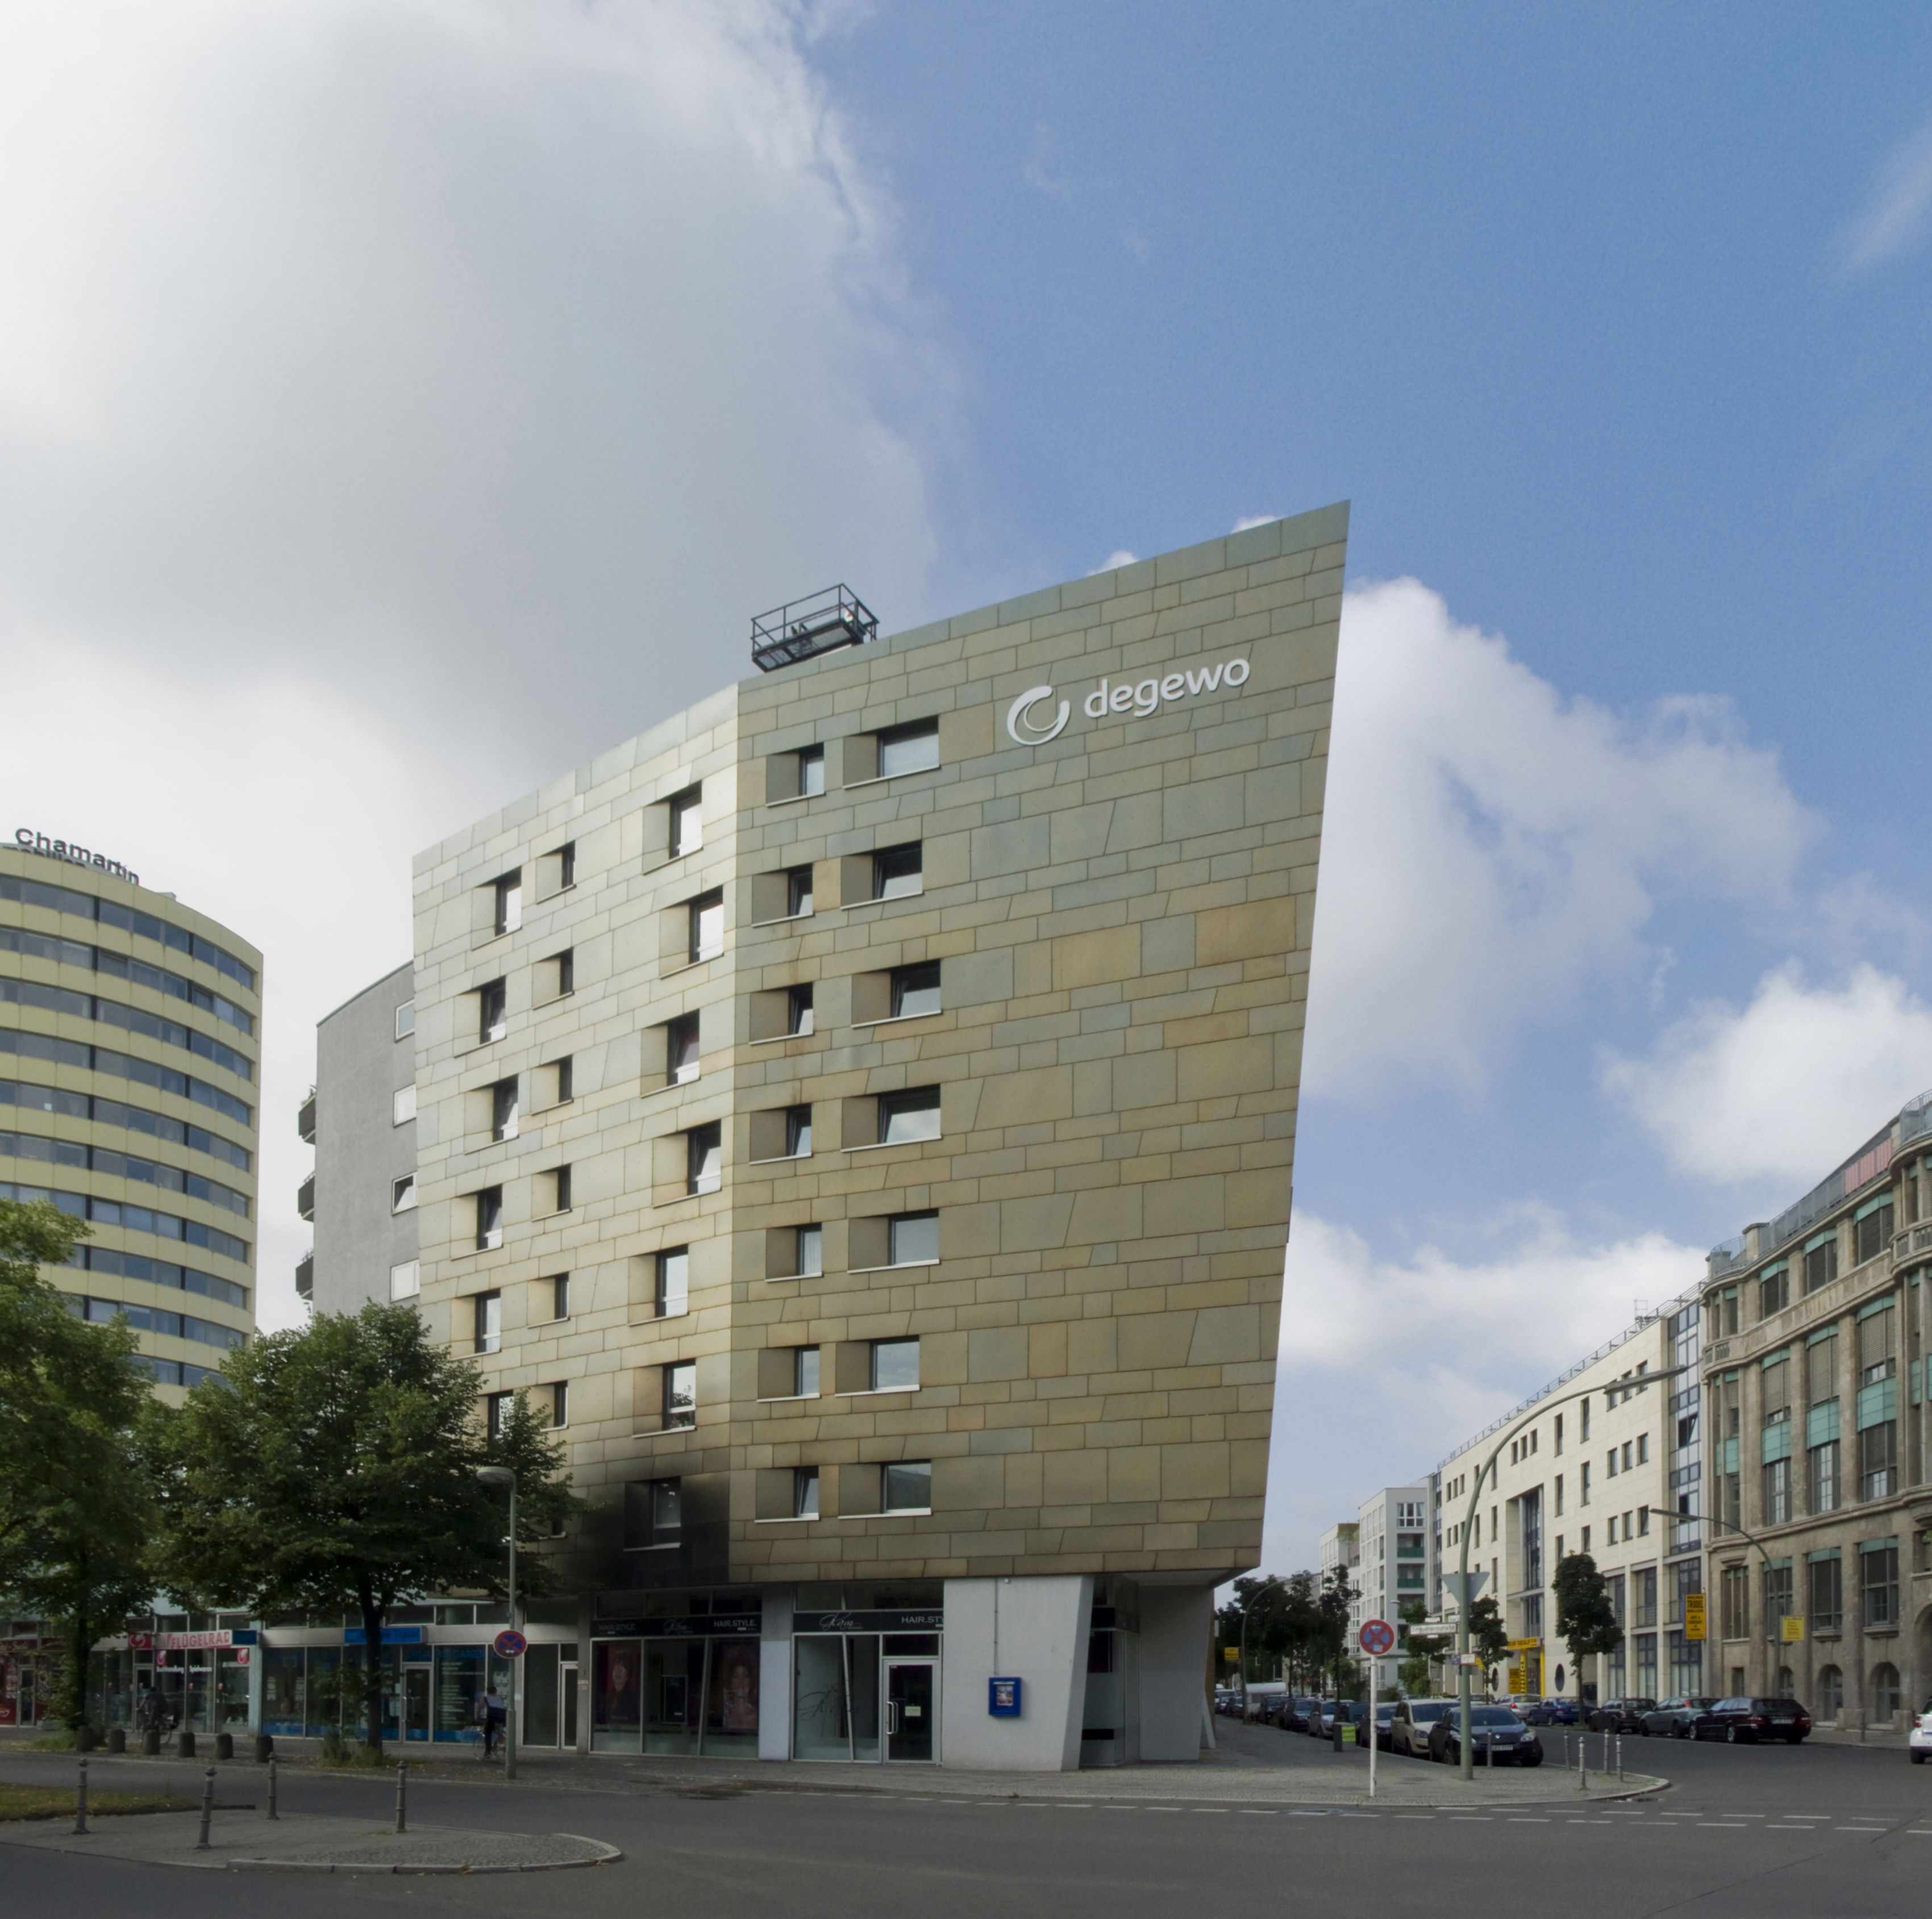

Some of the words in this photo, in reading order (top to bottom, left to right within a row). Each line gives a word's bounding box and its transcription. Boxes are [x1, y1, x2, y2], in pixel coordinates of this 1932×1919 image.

[1084, 658, 1250, 717] degewo
[15, 828, 140, 885] Chamartin
[394, 1629, 419, 1639] Travel
[1412, 1624, 1455, 1633] Stresemannstraße
[171, 1632, 230, 1649] FLÜGELRAD
